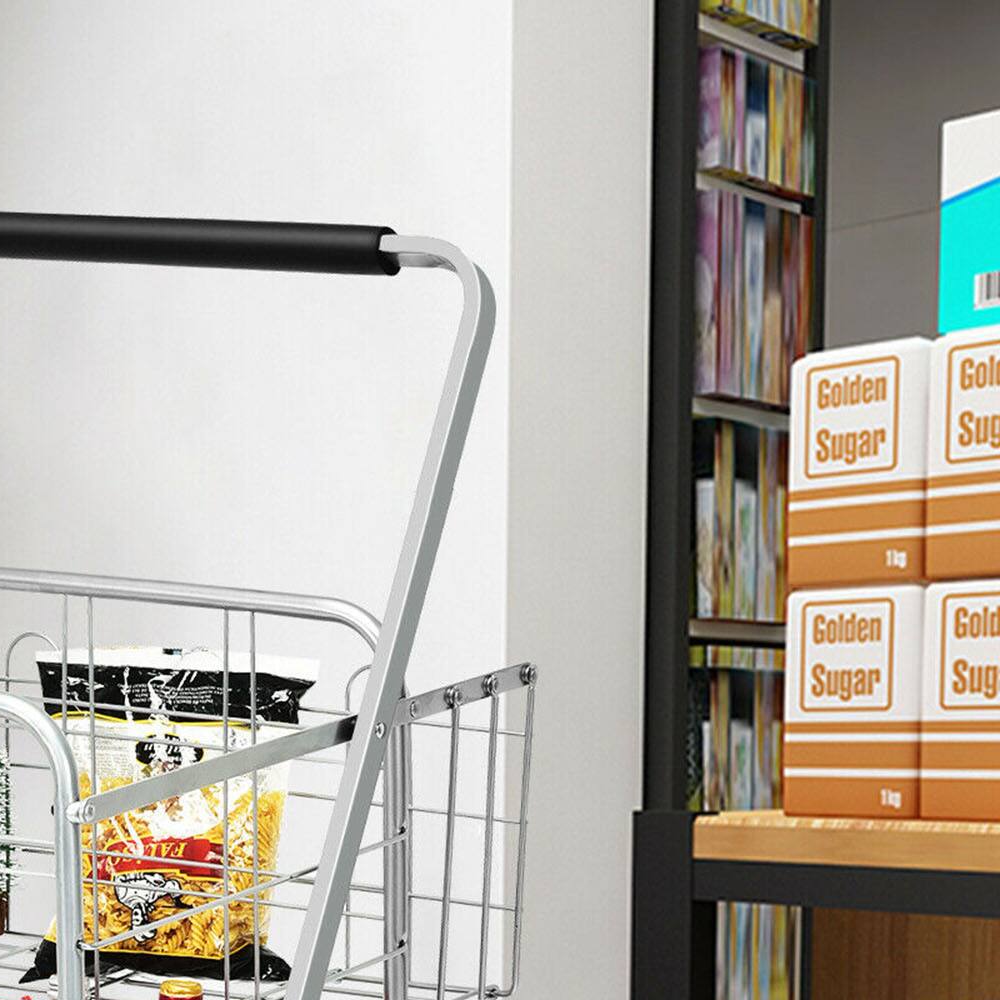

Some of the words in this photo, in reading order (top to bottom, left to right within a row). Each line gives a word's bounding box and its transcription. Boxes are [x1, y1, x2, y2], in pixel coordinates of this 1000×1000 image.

[959, 354, 1000, 391] Gol
[817, 374, 887, 410] Golden
[816, 428, 886, 464] Sugar
[812, 613, 882, 645] Golden
[811, 663, 881, 702] Sugar
